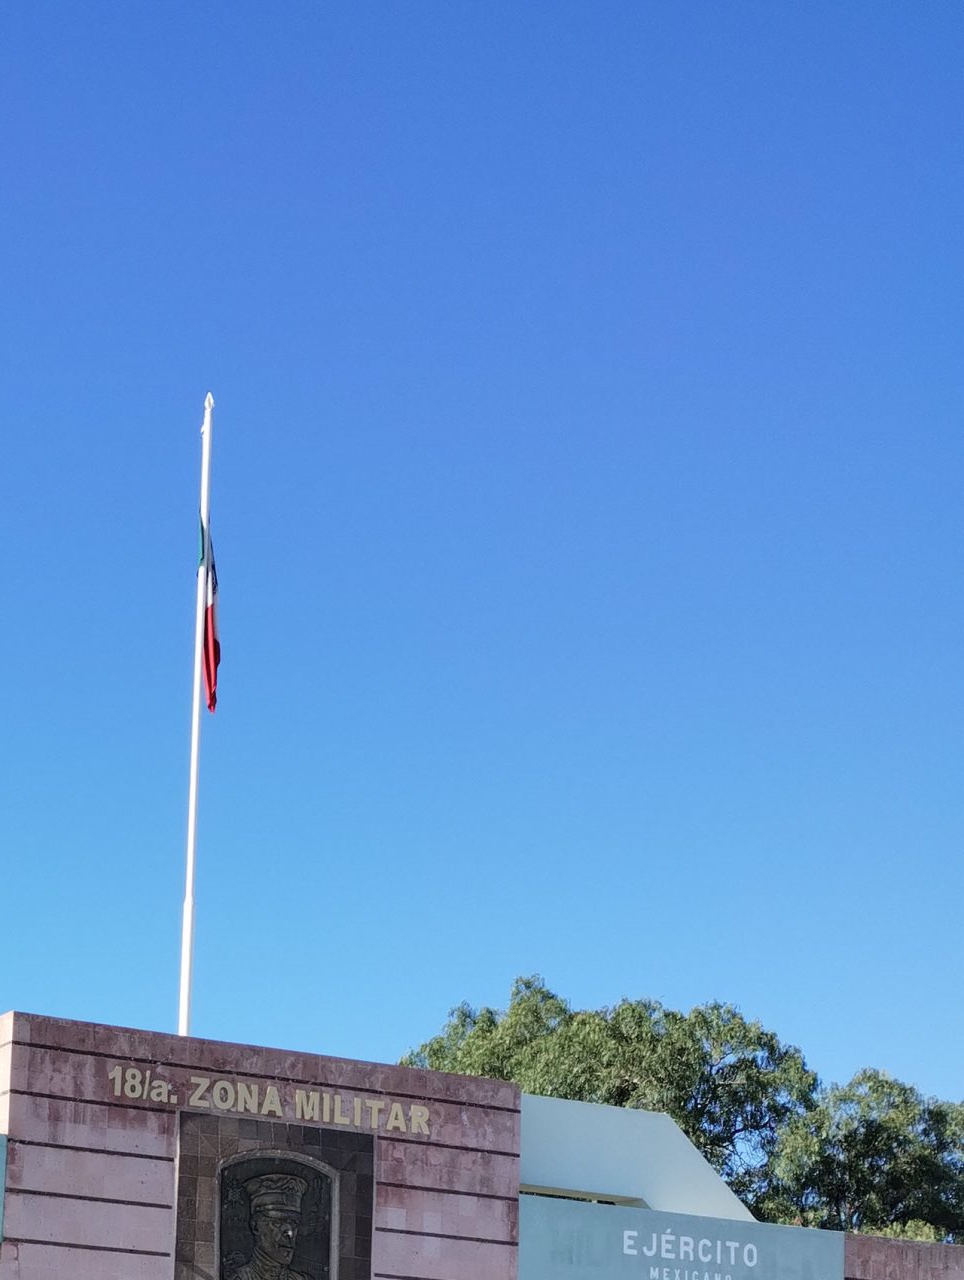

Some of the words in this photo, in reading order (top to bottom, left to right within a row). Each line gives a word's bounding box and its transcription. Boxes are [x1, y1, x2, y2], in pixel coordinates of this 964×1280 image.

[188, 1076, 283, 1118] ZONA
[294, 1089, 431, 1135] MILITAR
[623, 1228, 758, 1267] EJÉRCITO
